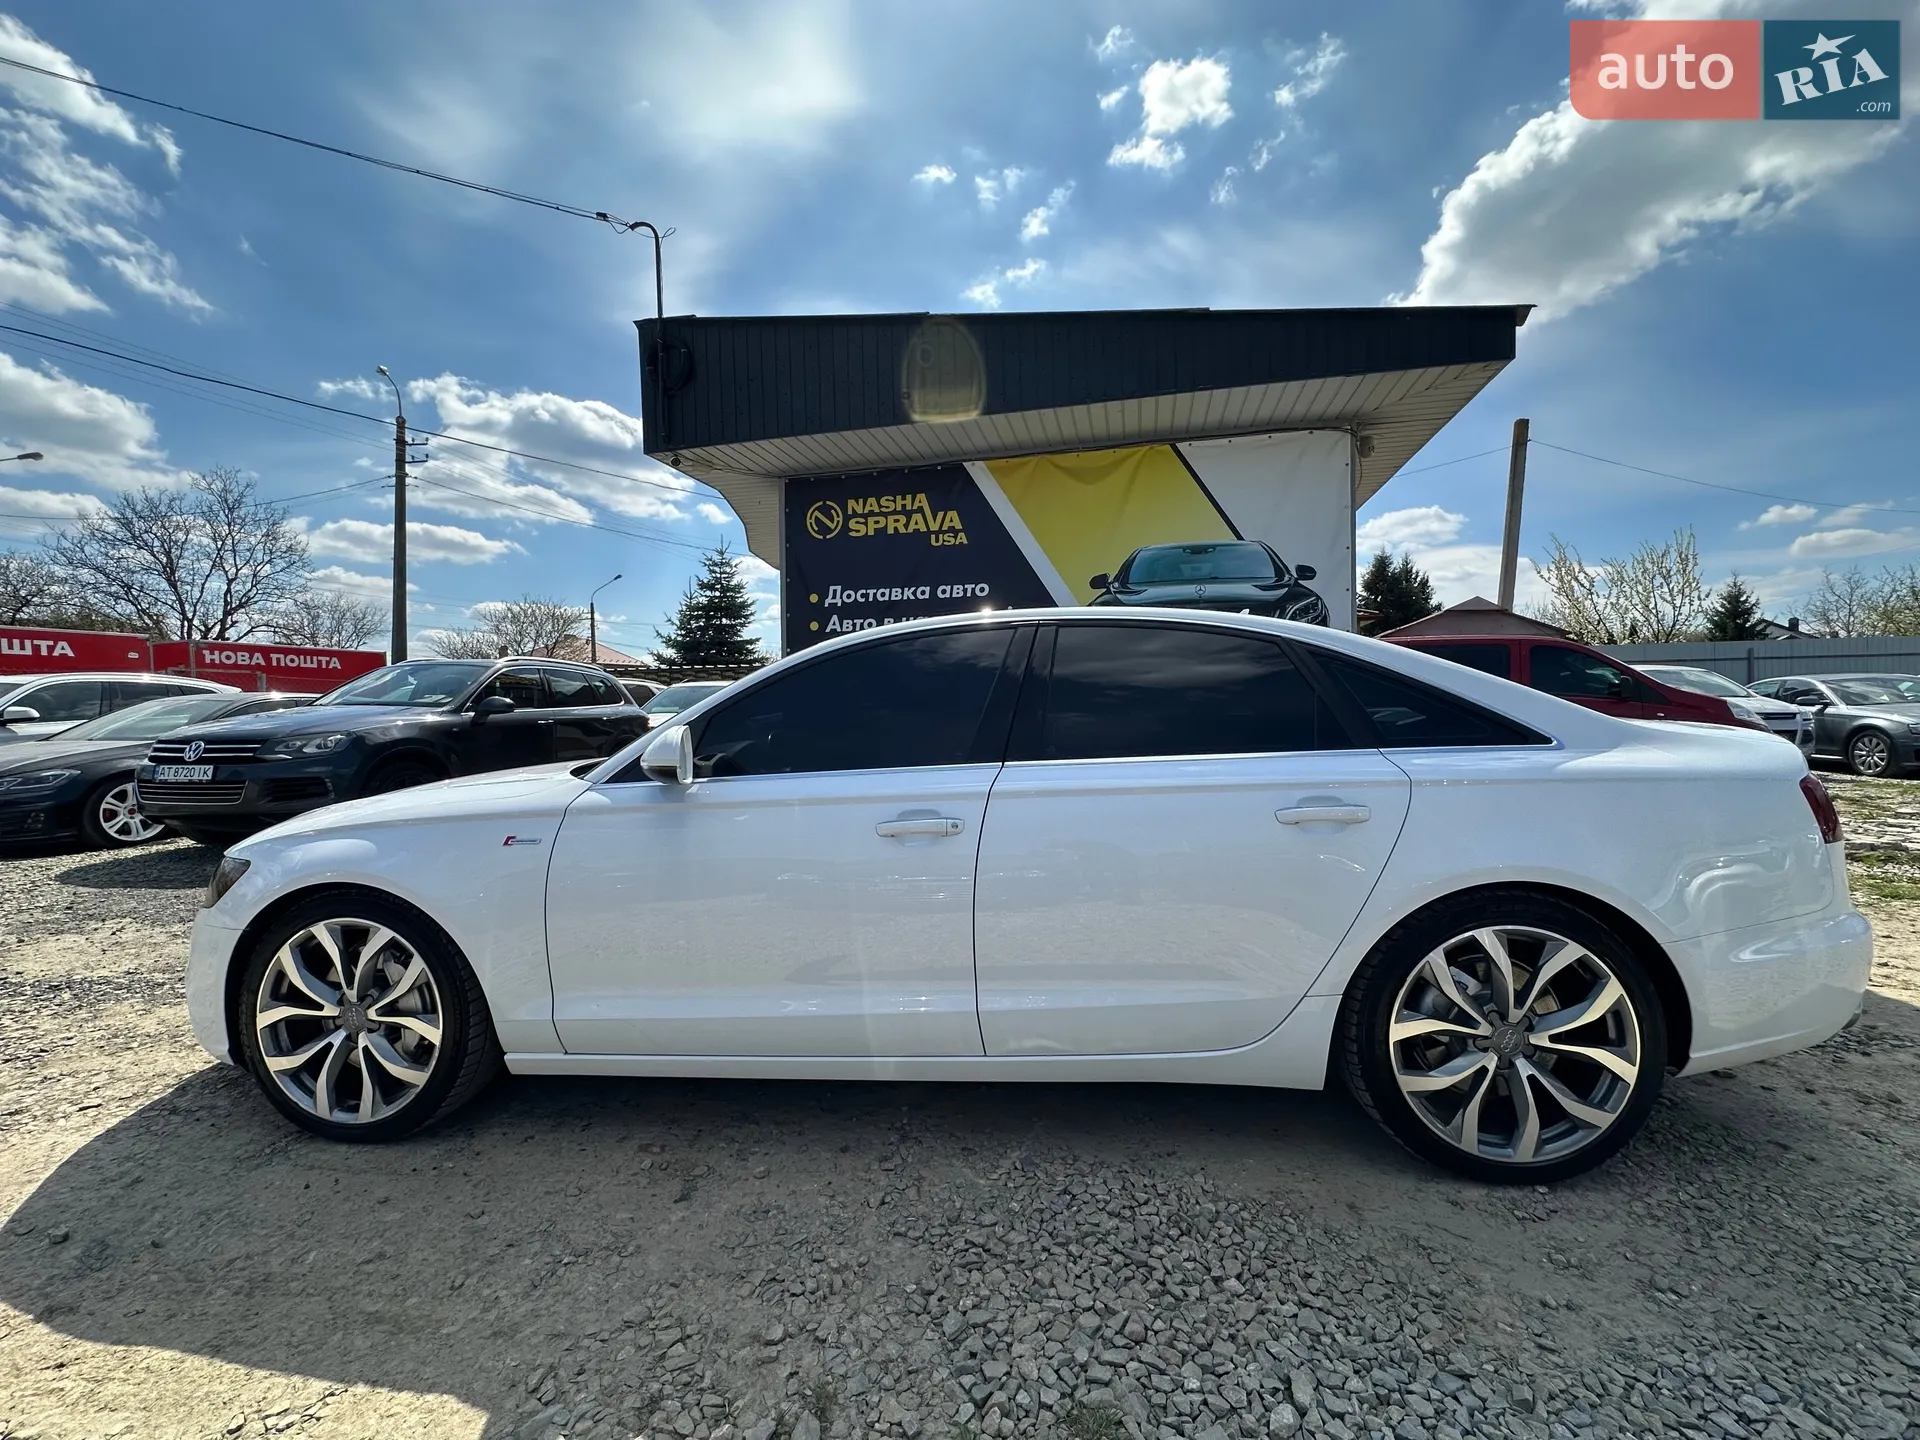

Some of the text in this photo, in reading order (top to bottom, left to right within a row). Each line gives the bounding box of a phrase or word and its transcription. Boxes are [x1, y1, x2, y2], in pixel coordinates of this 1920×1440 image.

[847, 493, 928, 514] NASHA
[848, 510, 963, 537] SPRAVA
[930, 532, 968, 547] USA
[824, 582, 990, 607] Доставка авто
[825, 614, 877, 633] Авто
[203, 650, 342, 669] НОВА ПОШТА
[173, 766, 196, 778] 8720
